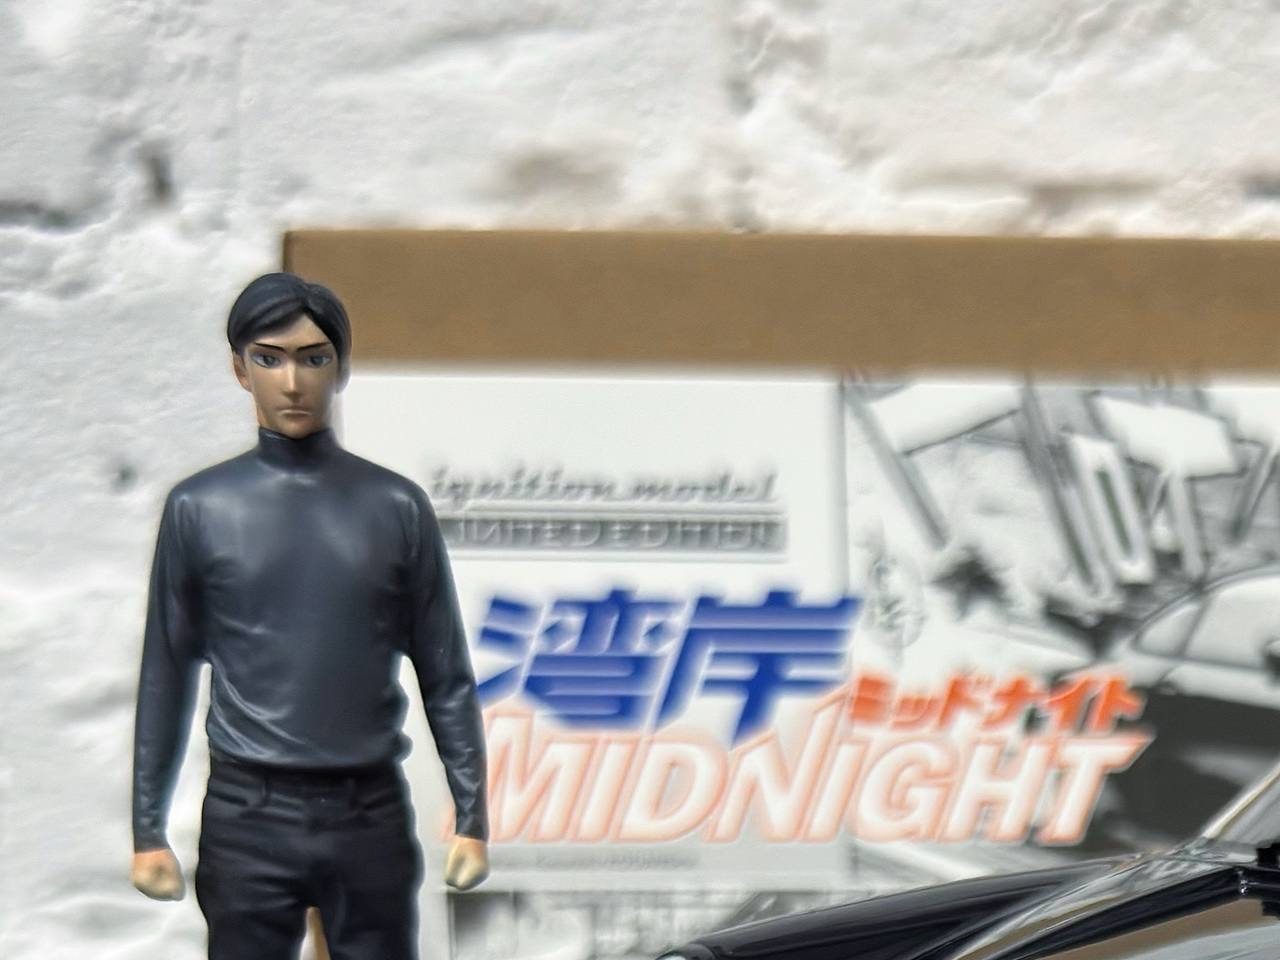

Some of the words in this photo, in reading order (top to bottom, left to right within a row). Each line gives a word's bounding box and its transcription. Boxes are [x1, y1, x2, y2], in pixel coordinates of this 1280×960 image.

[428, 466, 616, 512] ignition
[628, 470, 776, 503] model
[477, 587, 860, 748] 湾岸
[851, 673, 1144, 731] ミッドナイト
[438, 678, 1153, 845] MIDNIGHT
